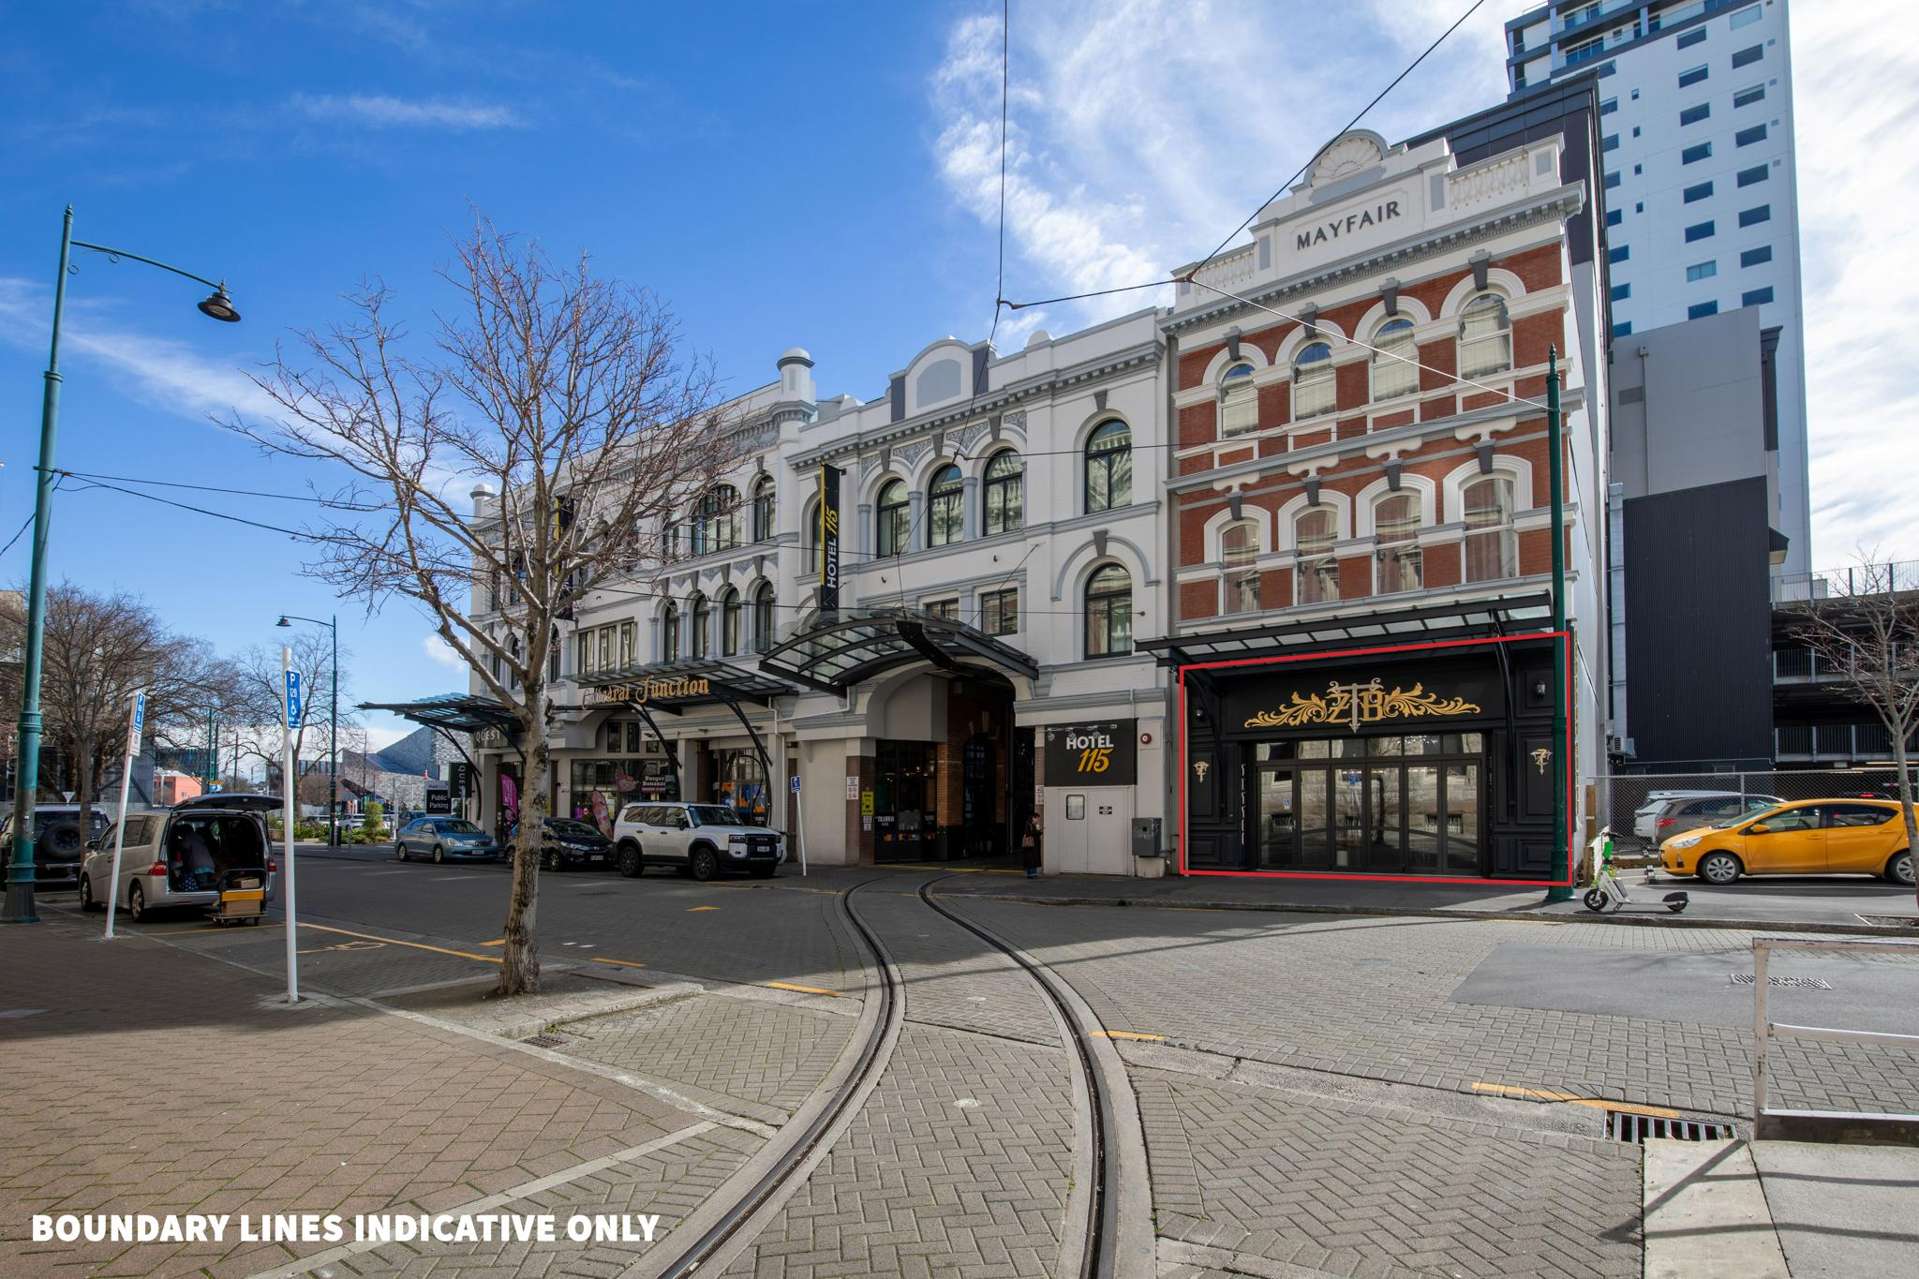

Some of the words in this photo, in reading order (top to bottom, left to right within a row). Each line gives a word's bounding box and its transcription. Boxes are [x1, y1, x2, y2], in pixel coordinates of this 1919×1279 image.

[1297, 201, 1400, 250] MAYFAIR
[826, 505, 838, 535] 115
[827, 538, 837, 588] HOTEL
[476, 728, 500, 743] QUEST
[1066, 735, 1114, 750] HOTEL
[1077, 748, 1114, 772] 115
